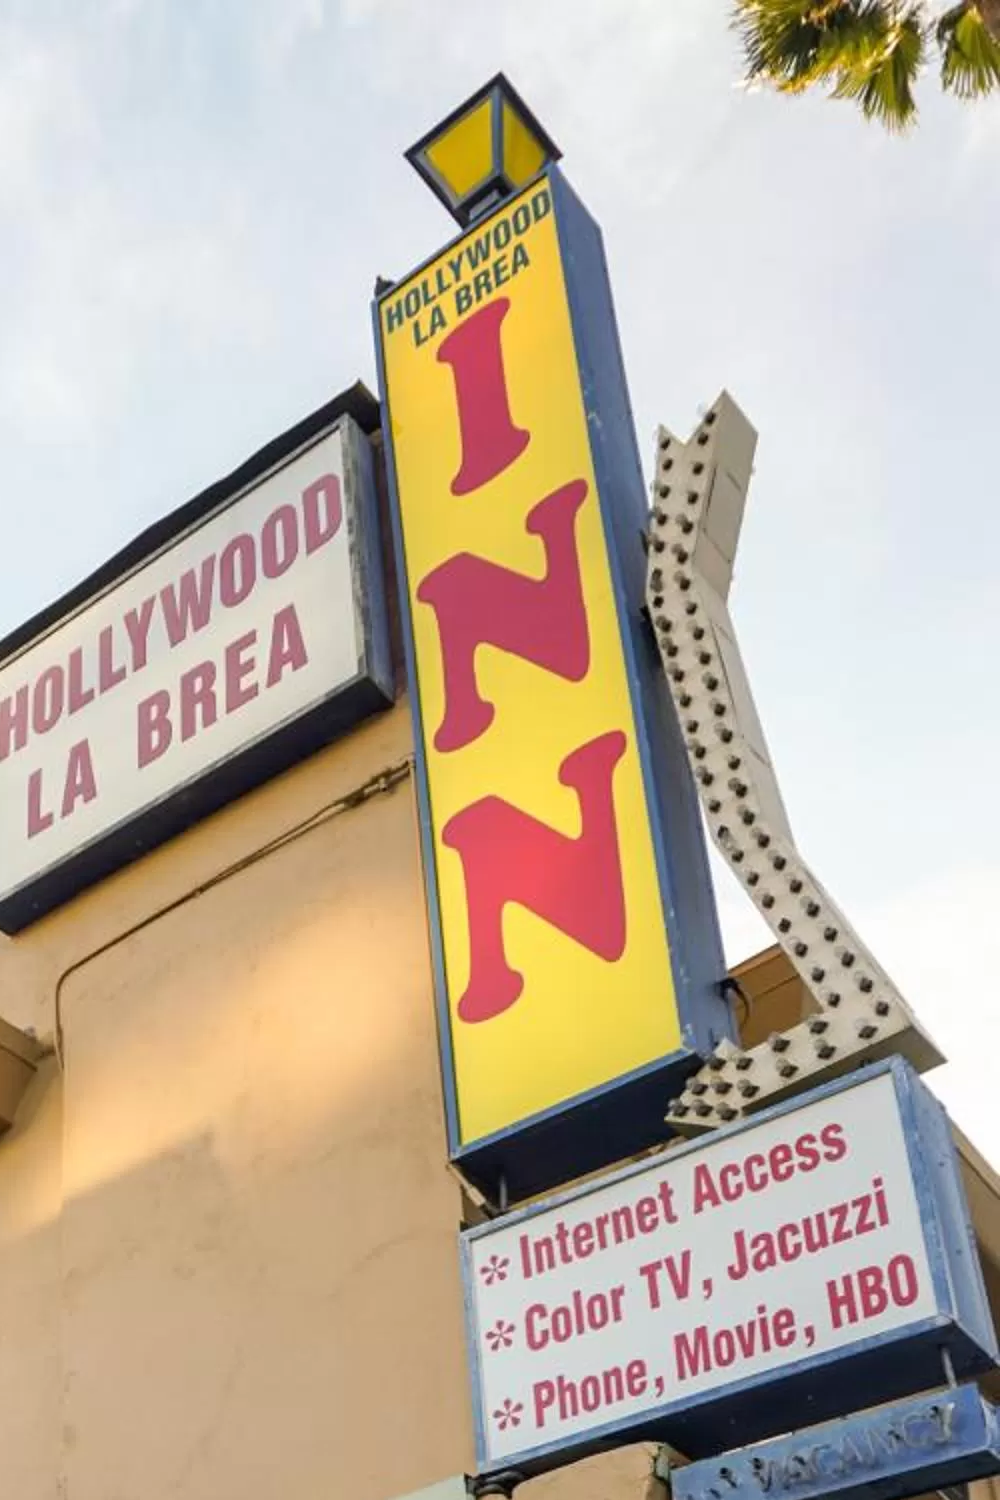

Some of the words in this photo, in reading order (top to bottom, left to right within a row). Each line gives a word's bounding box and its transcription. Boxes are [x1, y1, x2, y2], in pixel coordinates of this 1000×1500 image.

[385, 187, 550, 334] HOLLYWOOD
[412, 303, 447, 349] LA
[454, 242, 530, 317] BREA
[26, 737, 98, 840] LA
[136, 603, 309, 769] BREA
[417, 296, 627, 1024] INN
[519, 1180, 679, 1280] Internet
[693, 1122, 848, 1215] Access
[524, 1283, 626, 1352] Color
[726, 1177, 890, 1281] Jacuzzi
[532, 1358, 665, 1429] Phone,
[673, 1303, 816, 1381] Movie,
[825, 1253, 920, 1330] HBO
